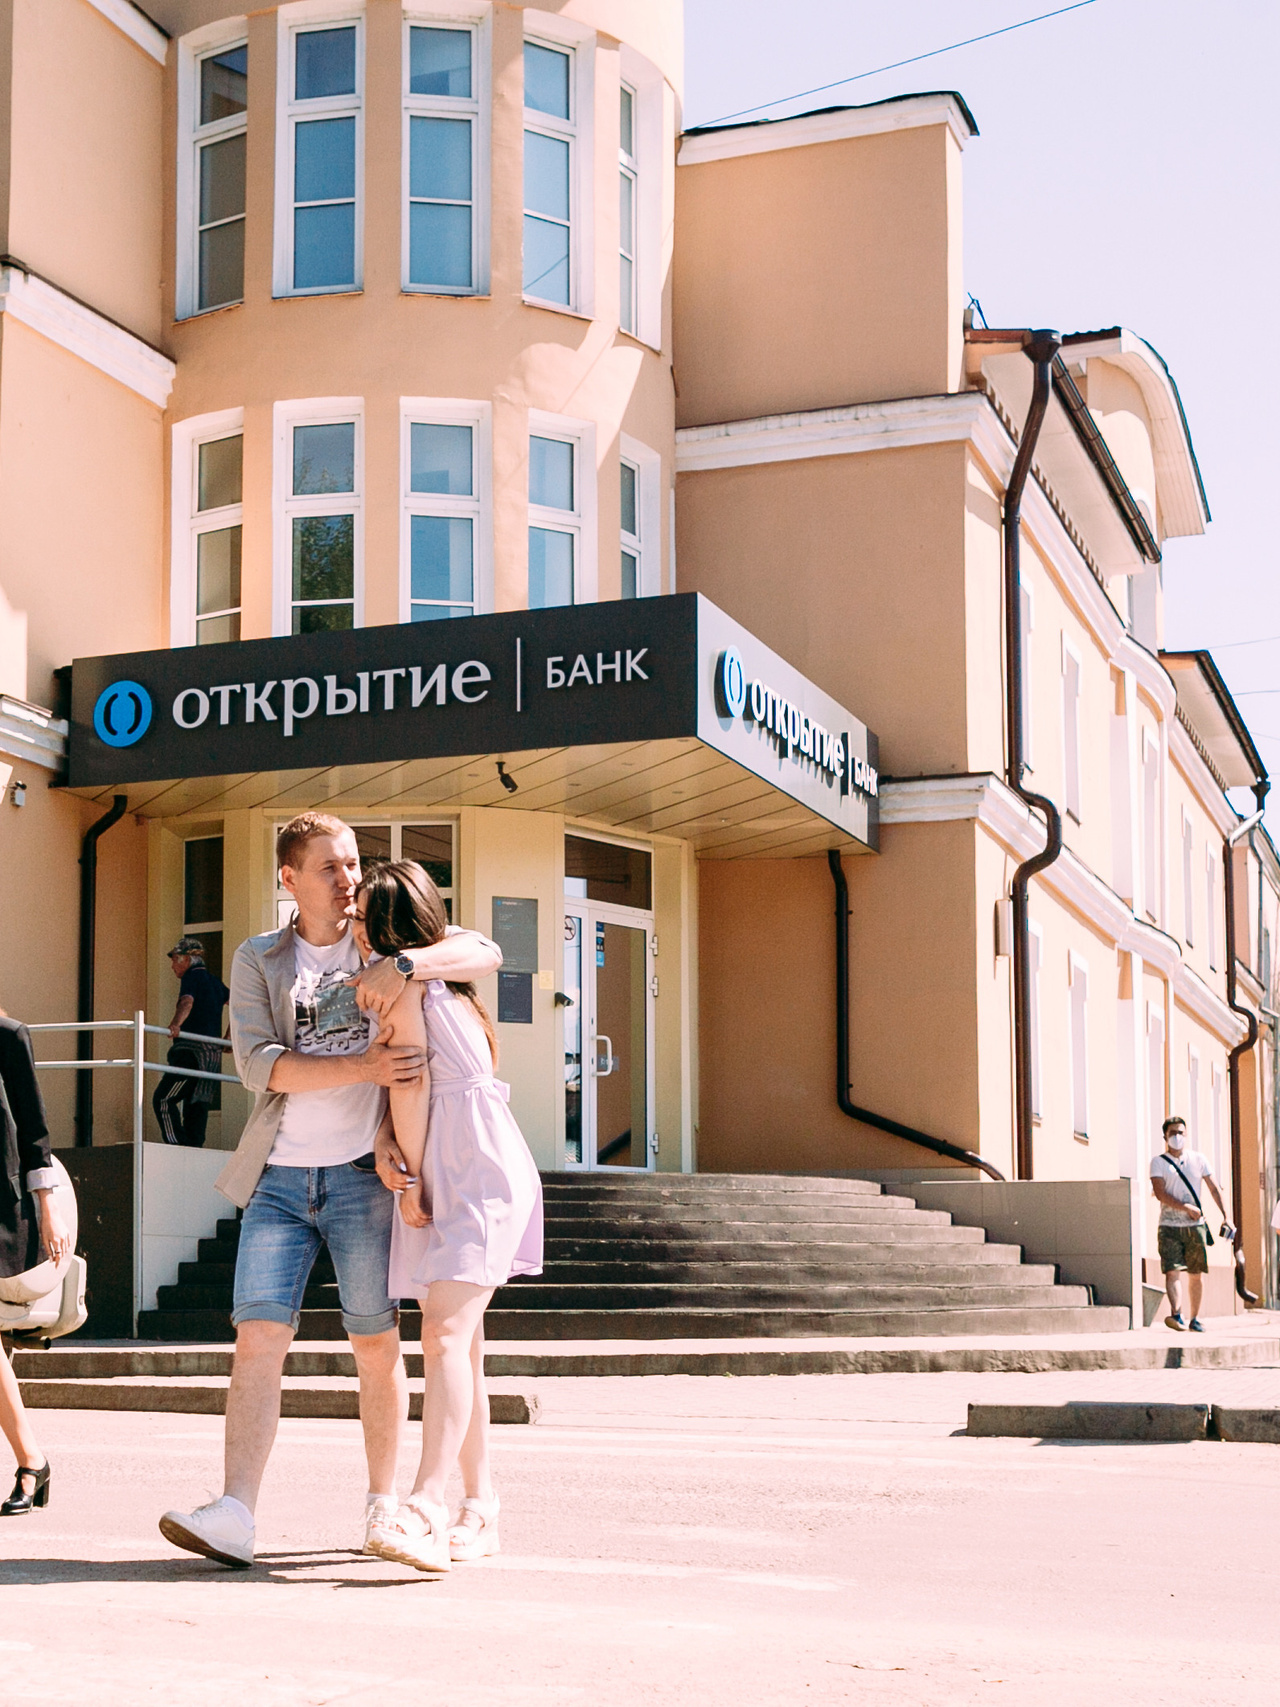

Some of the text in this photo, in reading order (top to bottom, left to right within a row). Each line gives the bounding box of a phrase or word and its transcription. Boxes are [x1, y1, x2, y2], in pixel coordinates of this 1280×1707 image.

[173, 647, 651, 737] открытие БАНК
[751, 677, 879, 798] открытие БАНК
